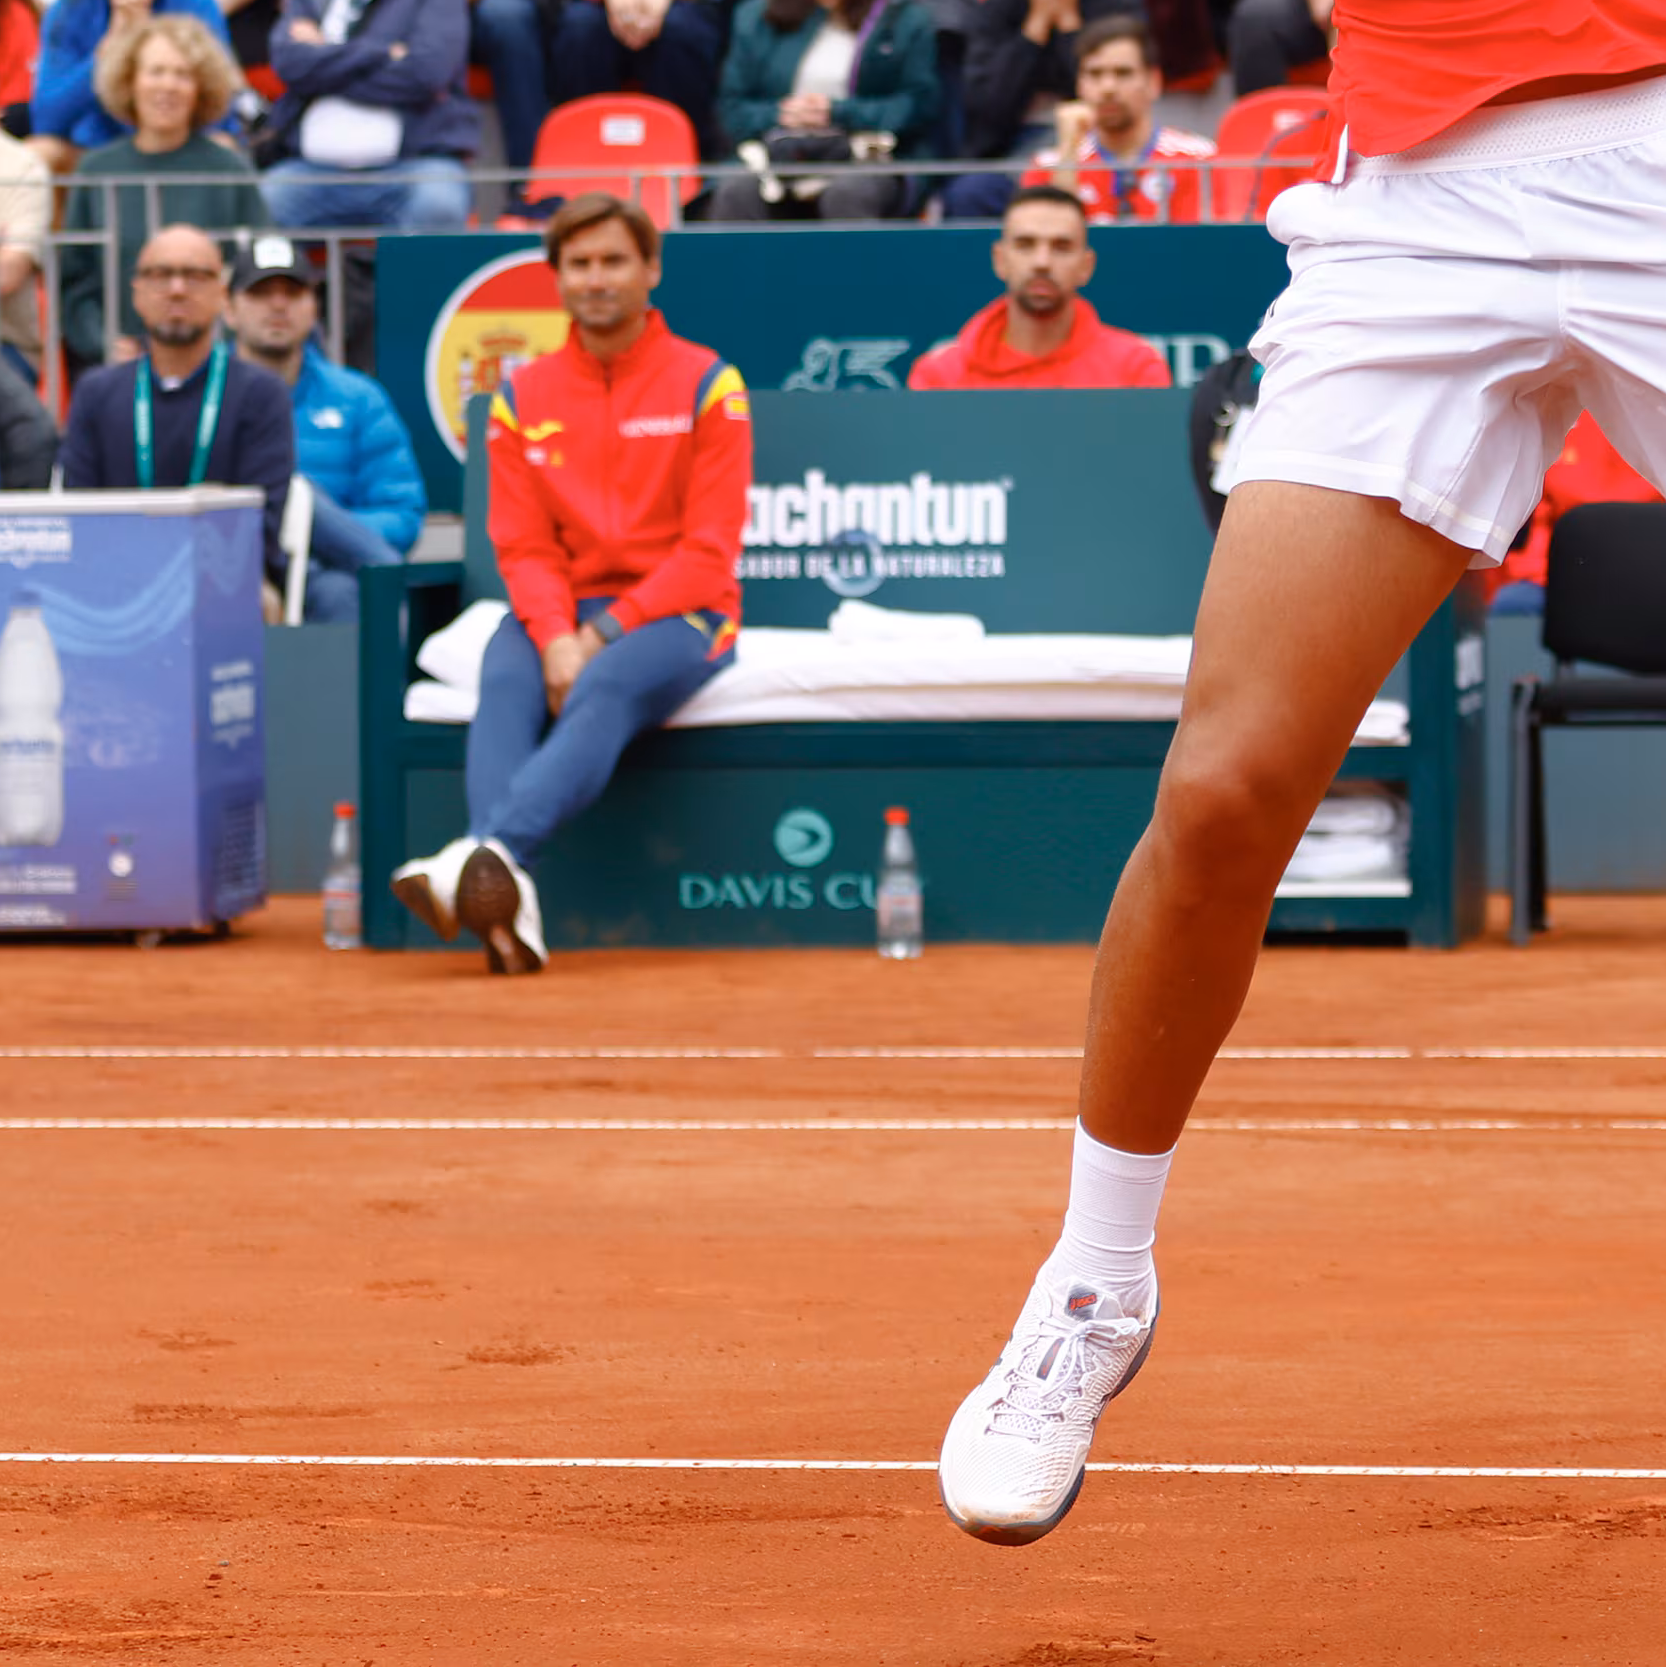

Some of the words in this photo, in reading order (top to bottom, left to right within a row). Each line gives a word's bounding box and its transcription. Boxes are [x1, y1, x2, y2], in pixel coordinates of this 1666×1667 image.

[741, 467, 1007, 546] achantun
[678, 871, 815, 910] DAVIS
[823, 872, 878, 910] CU
